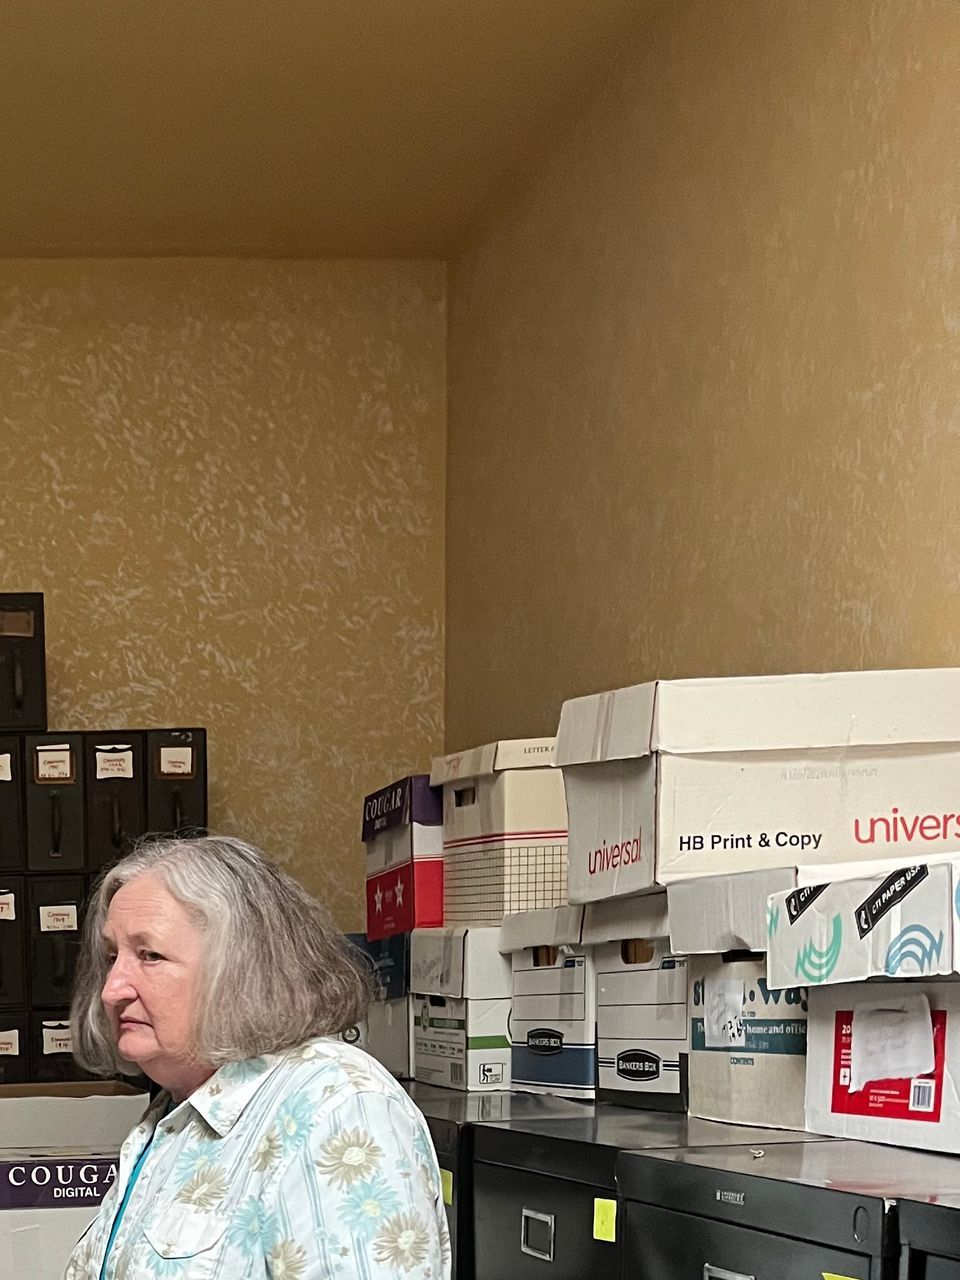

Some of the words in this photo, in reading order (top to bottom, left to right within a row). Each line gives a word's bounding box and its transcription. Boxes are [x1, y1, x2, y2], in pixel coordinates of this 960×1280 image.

[365, 788, 402, 821] COUGAR
[588, 827, 642, 875] universal
[679, 834, 704, 851] HB
[711, 832, 752, 850] Print
[759, 833, 771, 848] &
[775, 831, 823, 850] Copy
[881, 877, 906, 903] PAPER
[619, 1060, 643, 1071] BANKERS
[53, 1187, 101, 1198] DIGITAL
